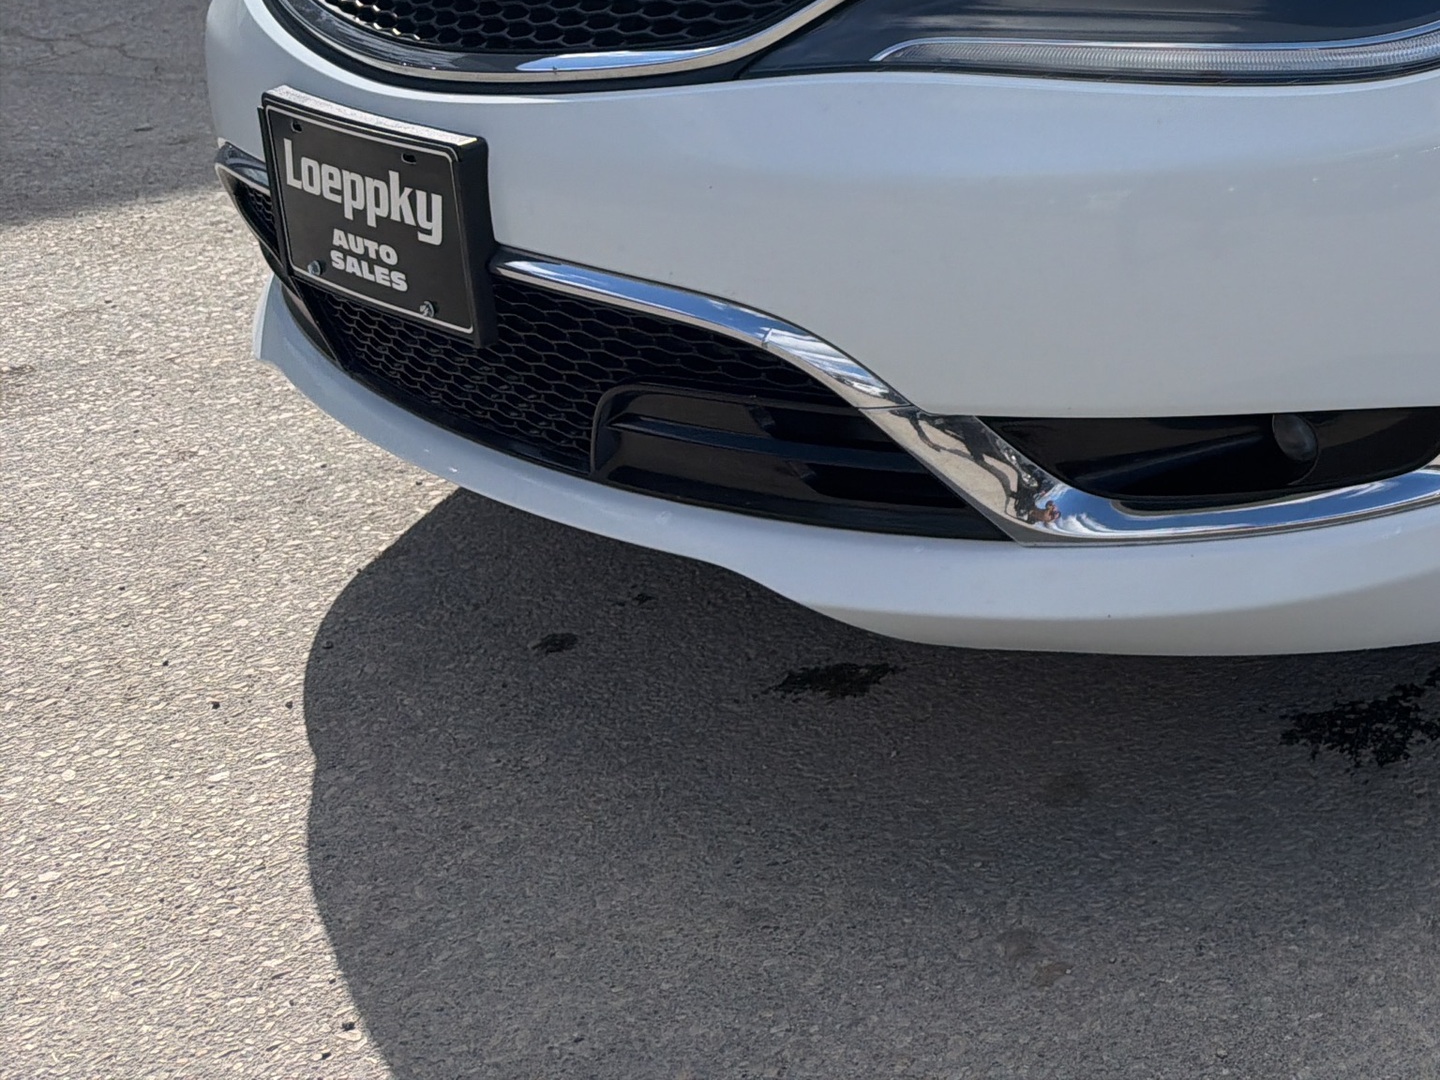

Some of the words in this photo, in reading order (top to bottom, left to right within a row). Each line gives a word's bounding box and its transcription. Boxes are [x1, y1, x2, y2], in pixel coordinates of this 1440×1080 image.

[283, 137, 443, 246] Loeppky
[332, 228, 399, 266] AUTO
[330, 249, 409, 292] SALES
